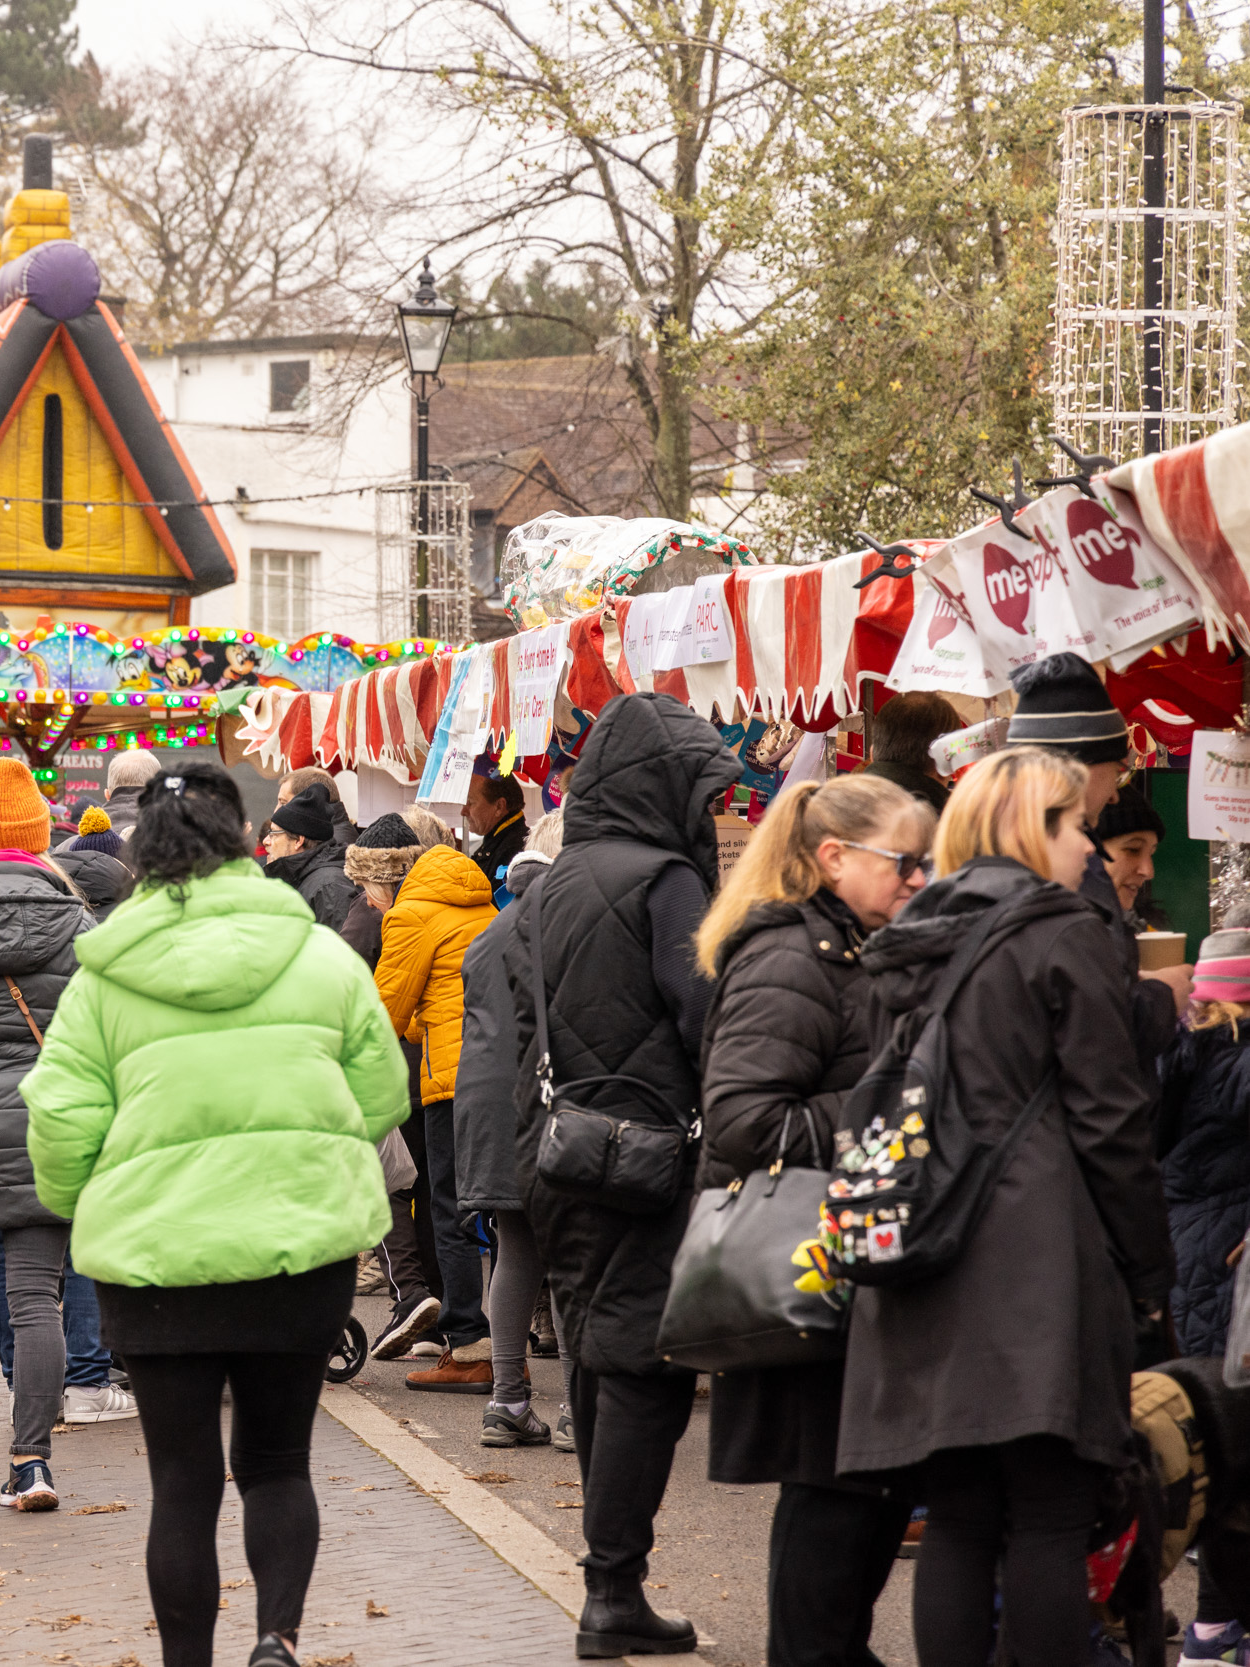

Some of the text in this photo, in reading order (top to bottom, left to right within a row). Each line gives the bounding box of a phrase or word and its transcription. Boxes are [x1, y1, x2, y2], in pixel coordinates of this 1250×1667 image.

[1072, 520, 1128, 567] me
[695, 602, 718, 634] PARC
[53, 754, 104, 769] TREATS
[65, 779, 100, 792] pples
[547, 787, 561, 798] beat
[717, 851, 740, 859] ckets
